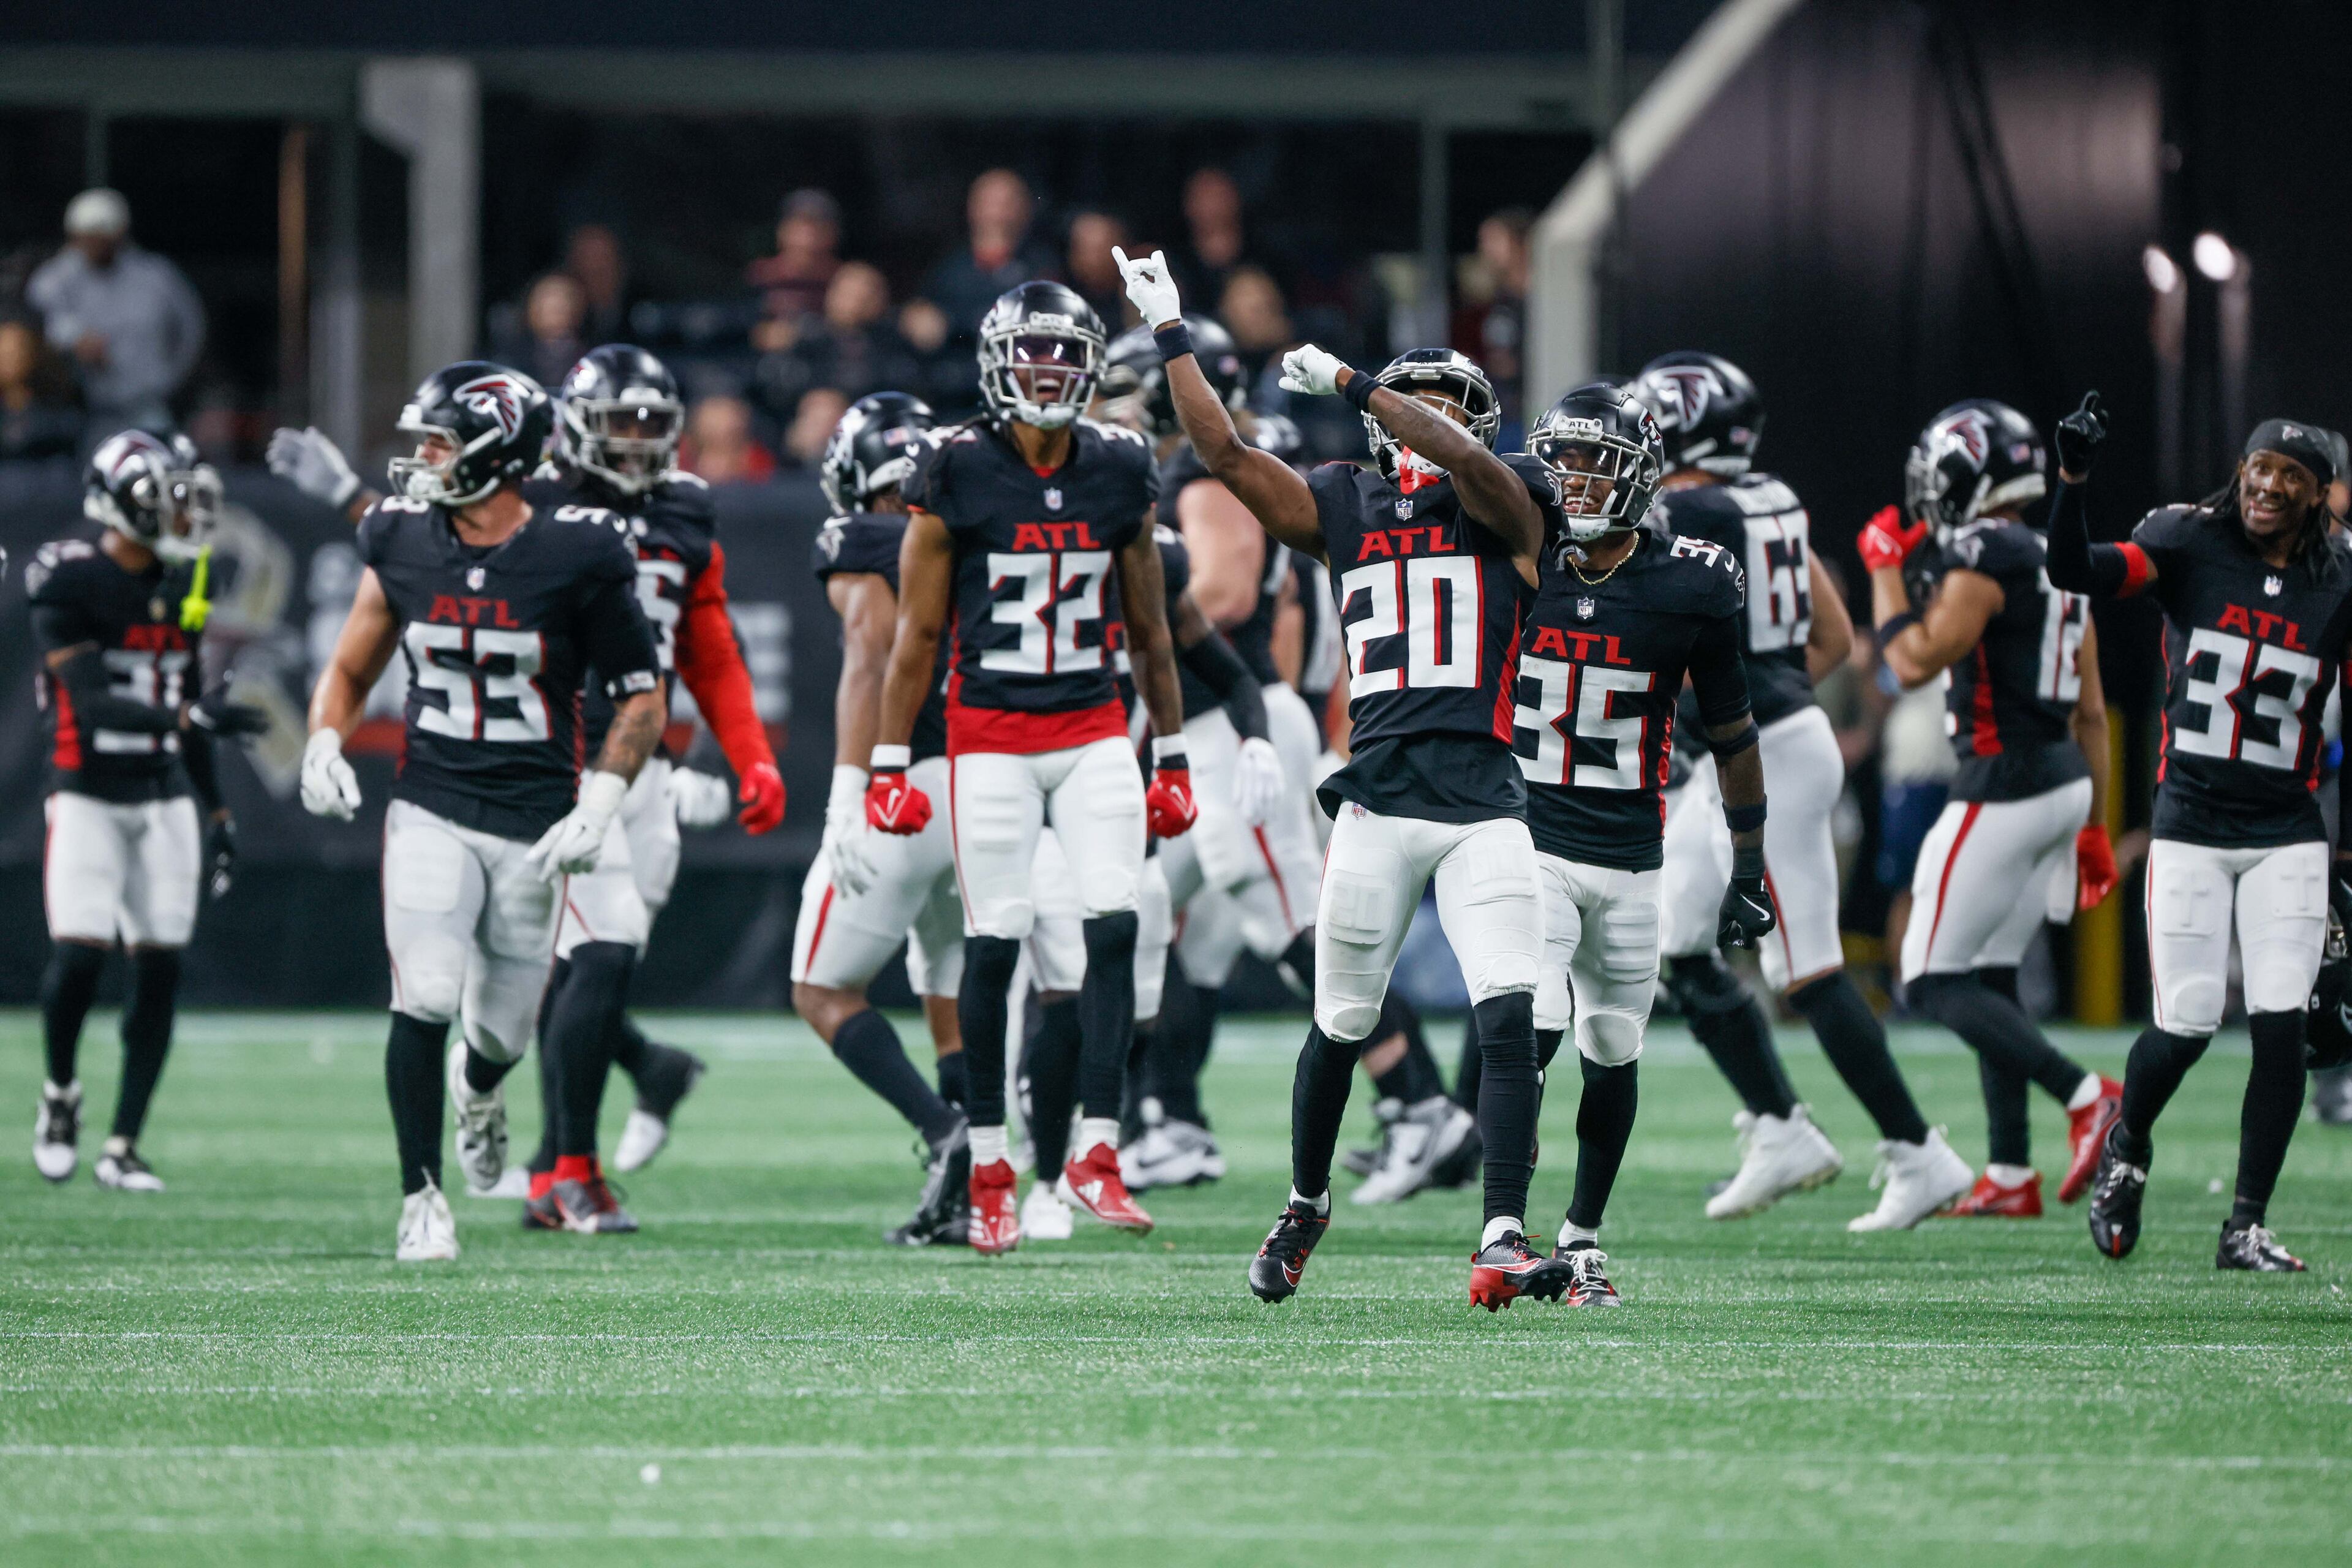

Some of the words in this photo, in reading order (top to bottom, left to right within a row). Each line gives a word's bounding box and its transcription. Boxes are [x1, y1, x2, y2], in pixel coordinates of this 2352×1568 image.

[1569, 421, 1591, 429] ATL
[1012, 522, 1101, 551] ATL
[1357, 526, 1455, 561] ATL
[430, 594, 519, 628] ATL
[980, 551, 1114, 674] 32
[1341, 556, 1483, 701] 20
[2217, 603, 2307, 650] ATL
[1532, 626, 1630, 665] ATL
[404, 620, 554, 742] 53
[2174, 627, 2323, 771] 33
[1512, 654, 1656, 790] 35
